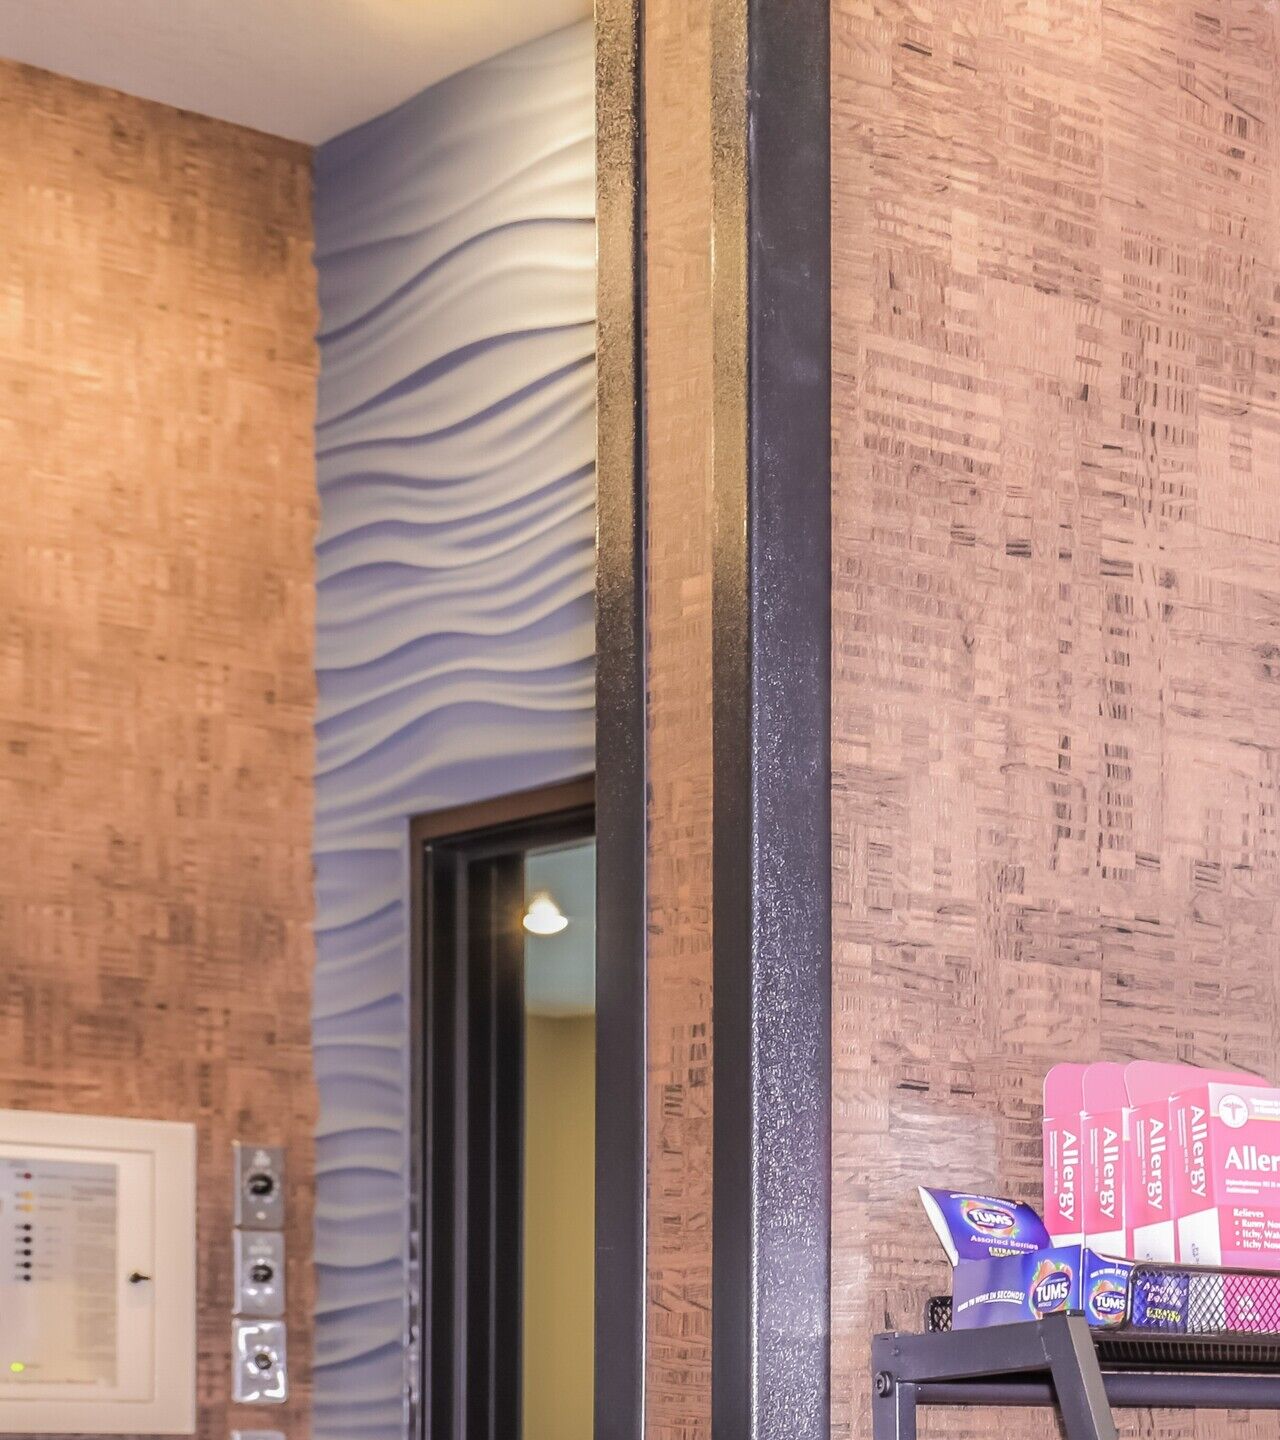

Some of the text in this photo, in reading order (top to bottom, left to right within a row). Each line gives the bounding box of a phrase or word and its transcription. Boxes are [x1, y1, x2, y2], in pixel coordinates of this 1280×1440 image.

[1190, 1105, 1208, 1198] Allergy
[1100, 1127, 1120, 1219] Allergy
[1147, 1118, 1167, 1210] Allergy
[1058, 1129, 1079, 1222] Allergy
[968, 1209, 1014, 1226] TUMS
[1233, 1208, 1265, 1218] Relieves
[1241, 1220, 1265, 1231] Runny
[1243, 1239, 1262, 1251] Itchy
[1036, 1282, 1069, 1303] TUMS
[1096, 1295, 1125, 1310] TUMS
